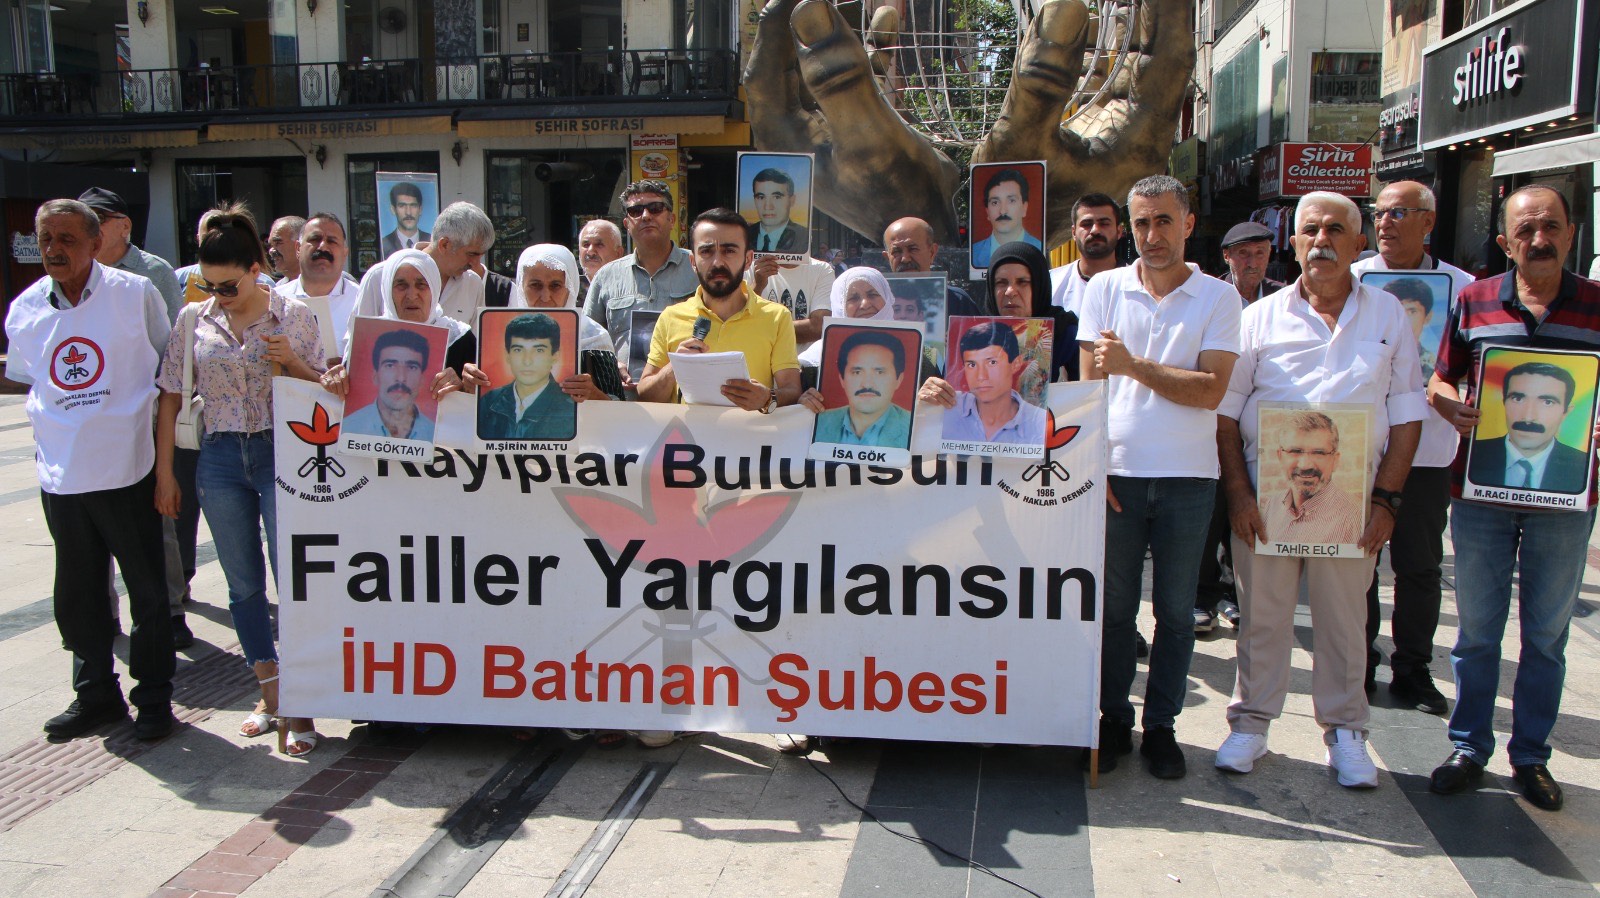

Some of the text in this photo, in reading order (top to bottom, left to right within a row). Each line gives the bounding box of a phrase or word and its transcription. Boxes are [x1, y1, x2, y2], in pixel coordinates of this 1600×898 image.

[1453, 28, 1520, 105] stilife
[320, 121, 377, 134] SOFRASI
[582, 118, 644, 131] SOFRASI
[80, 135, 132, 145] SOFRASI
[632, 138, 676, 147] SOFRASI
[1300, 146, 1355, 166] Şirin
[1288, 164, 1366, 176] Collection
[348, 440, 424, 456] Eset GÖKTAYI
[486, 442, 527, 452] M.ŞİRİN
[942, 442, 1042, 455] MEHMET ZEKİ AKYILDIZ
[832, 447, 886, 462] İSA GÖK
[275, 476, 369, 502] İNSAN HAKLARI DERNEĞİ
[313, 485, 331, 493] 1986
[997, 479, 1094, 506] İNSAN HAKLARI DERNEĞİ
[1036, 489, 1055, 497] 1986
[1474, 489, 1576, 506] M.RACİ DEĞİRMENCİ
[1275, 544, 1339, 556] TAHİR ELÇİ
[291, 534, 1096, 632] Failler Yargılansın
[343, 627, 1008, 722] İHD Batman Şubesi
